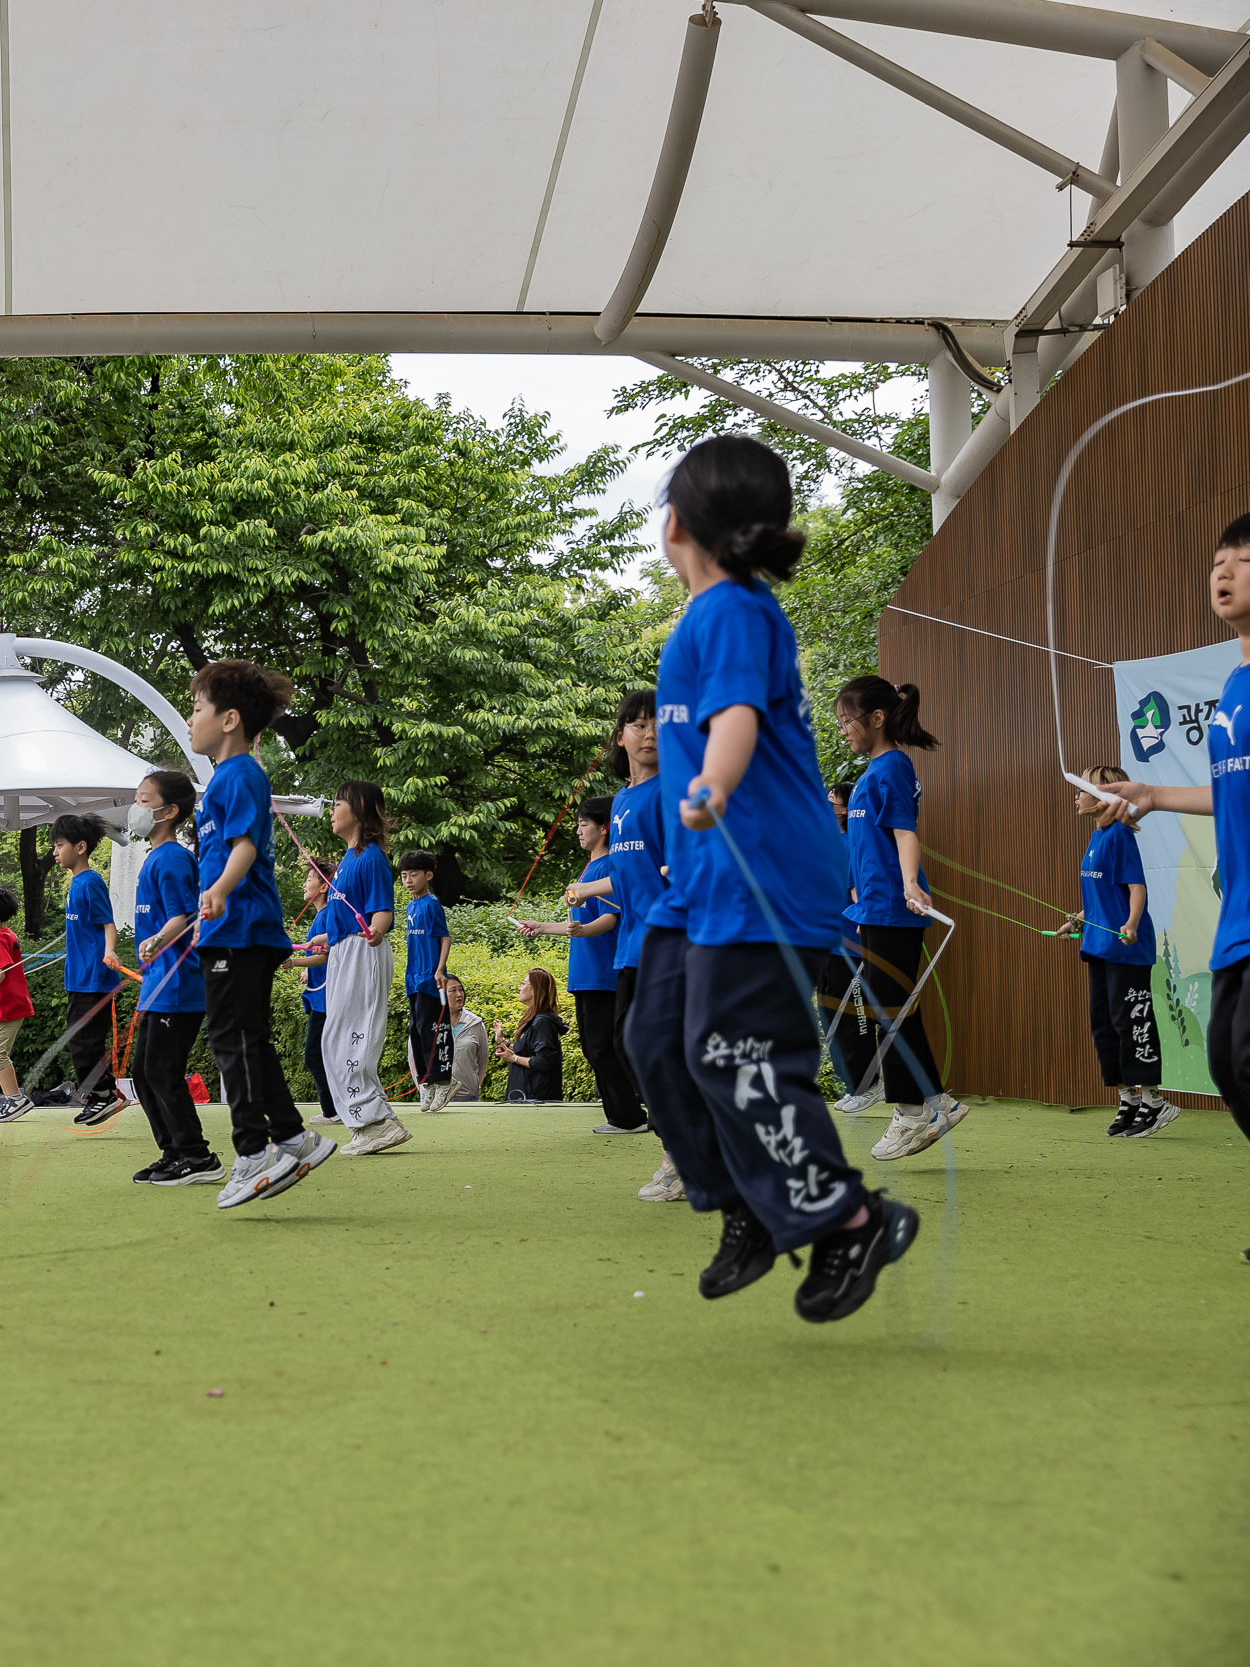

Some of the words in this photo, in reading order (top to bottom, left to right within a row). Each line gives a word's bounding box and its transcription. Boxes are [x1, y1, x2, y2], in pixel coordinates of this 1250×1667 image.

[615, 841, 644, 853] FASTER
[1130, 1001, 1159, 1063] 시범단
[734, 1061, 847, 1212] 시범단
